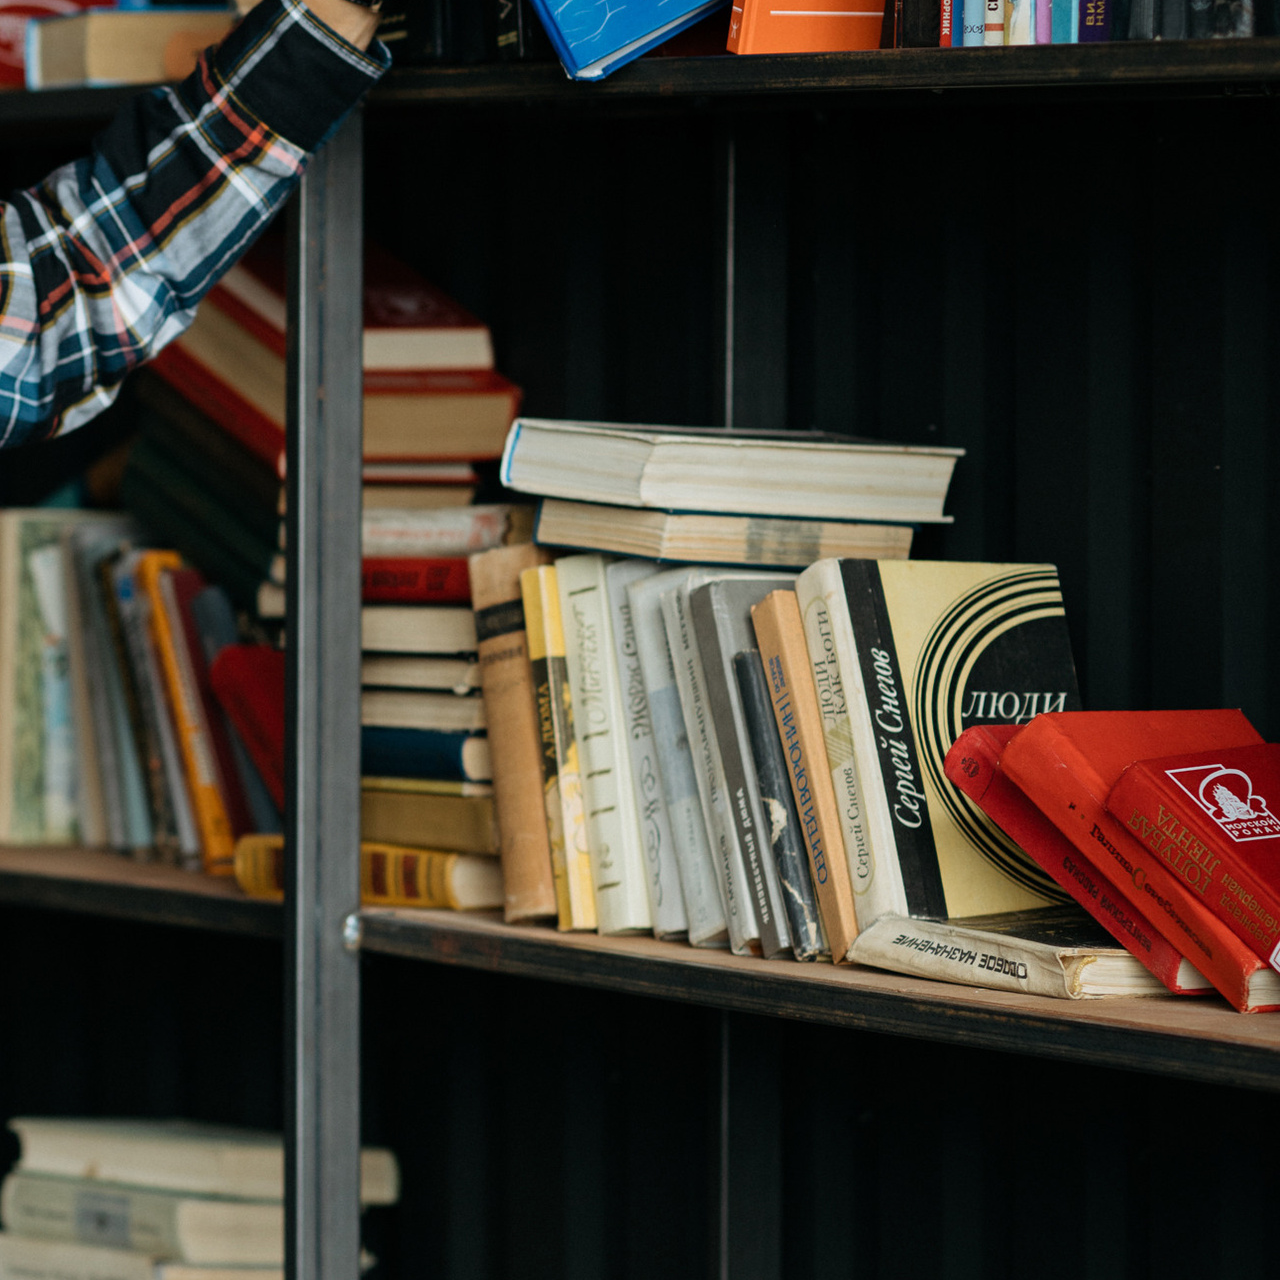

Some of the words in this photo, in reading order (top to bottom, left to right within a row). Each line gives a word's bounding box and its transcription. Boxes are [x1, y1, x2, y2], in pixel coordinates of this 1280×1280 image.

[814, 609, 838, 666] БОГИ
[812, 659, 839, 724] ЛЮДИ
[828, 670, 849, 715] КАК
[867, 645, 904, 735] Снегов
[961, 690, 1068, 722] ЛЮДИ
[777, 702, 813, 805] ВОРОНИН
[880, 738, 927, 829] Сергей
[733, 787, 753, 828] ДЮМА
[839, 766, 862, 821] Снегов
[1225, 817, 1276, 830] МОРСКОЙ
[799, 805, 831, 884] СЕРГЕЙ
[847, 822, 874, 879] Сергей
[1124, 811, 1214, 896] ГОЛУБАЯ
[1149, 801, 1224, 877] ЛЕНТА
[742, 832, 771, 924] НЕИЗВЕСТНЫЙ
[892, 933, 977, 966] НАЗНАЧЕНИЕ
